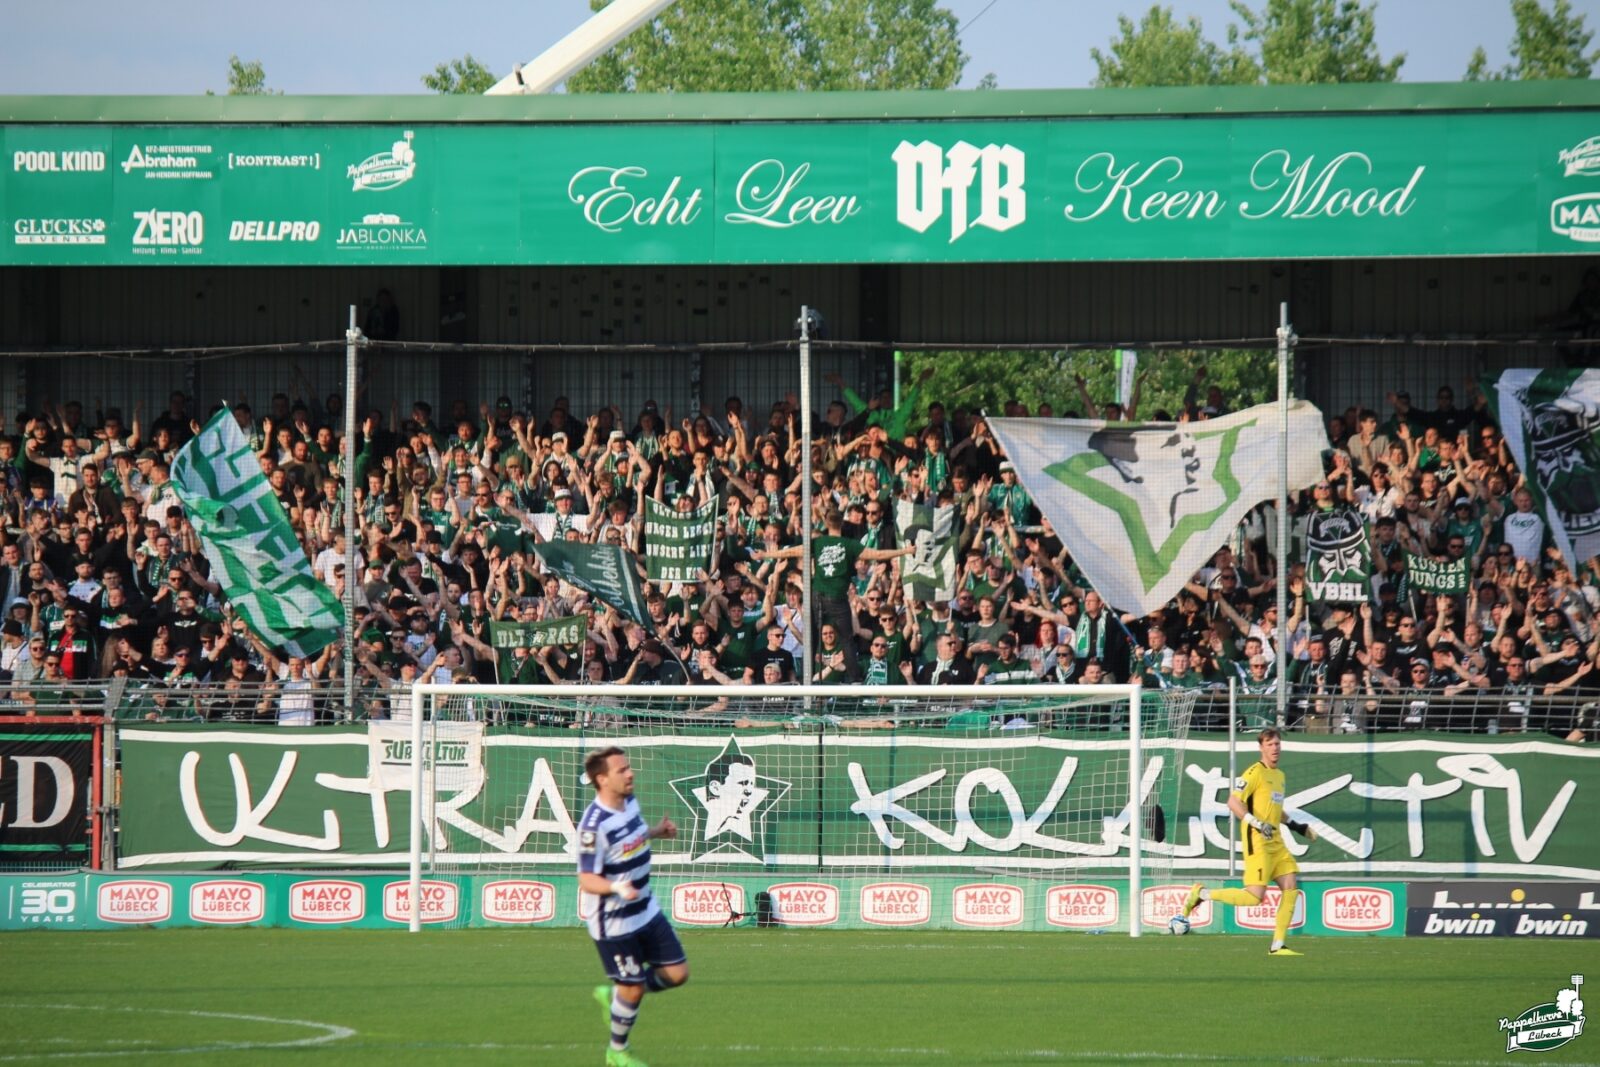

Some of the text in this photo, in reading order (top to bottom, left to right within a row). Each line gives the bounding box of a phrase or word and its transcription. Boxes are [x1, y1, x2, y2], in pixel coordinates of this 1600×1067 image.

[14, 151, 105, 172] POOL KIND
[121, 144, 196, 173] Abraham
[568, 166, 702, 232] Echt
[724, 158, 862, 229] Leev
[1064, 151, 1227, 223] Keen
[1239, 149, 1426, 219] Mood
[1560, 204, 1600, 225] MA
[14, 219, 93, 234] GLÜCKS
[229, 221, 320, 241] DELLPRO
[29, 235, 92, 243] EVENTS
[336, 228, 427, 244] JABLONKA
[1409, 569, 1456, 589] JUNGS
[1308, 581, 1368, 600] VBHL
[0, 755, 75, 828] D
[1257, 868, 1263, 881] 1
[110, 887, 159, 900] MAYO
[202, 888, 252, 900] MAYO
[302, 888, 352, 900] MAYO
[396, 887, 446, 900] MYO
[494, 888, 543, 900] MAYO
[684, 889, 732, 902] MAYO
[779, 890, 827, 902] MAYO
[873, 890, 919, 902] MAYO
[965, 891, 1012, 903] MAYO
[1058, 892, 1106, 904] MAYO
[1153, 892, 1187, 905] MAY
[20, 889, 75, 914] 30
[110, 901, 158, 912] LÜBECK
[202, 901, 250, 912] LÜBECK
[302, 901, 352, 912] LÜBECK
[396, 901, 445, 912] LÜECK
[494, 901, 543, 912] LÜBECK
[1334, 894, 1382, 908] MAYO
[684, 902, 731, 913] LÜBECK
[779, 902, 826, 914] LÜBECK
[873, 903, 919, 914] LÜBECK
[965, 904, 1011, 915] LÜBECK
[1058, 905, 1105, 916] LÜBECK
[1153, 906, 1200, 916] LÜBEK
[1247, 907, 1276, 918] LÜBE
[20, 915, 75, 923] YEARS
[1334, 909, 1381, 919] LÜBECK
[1424, 912, 1496, 934] bwin
[1515, 913, 1588, 935] bwin
